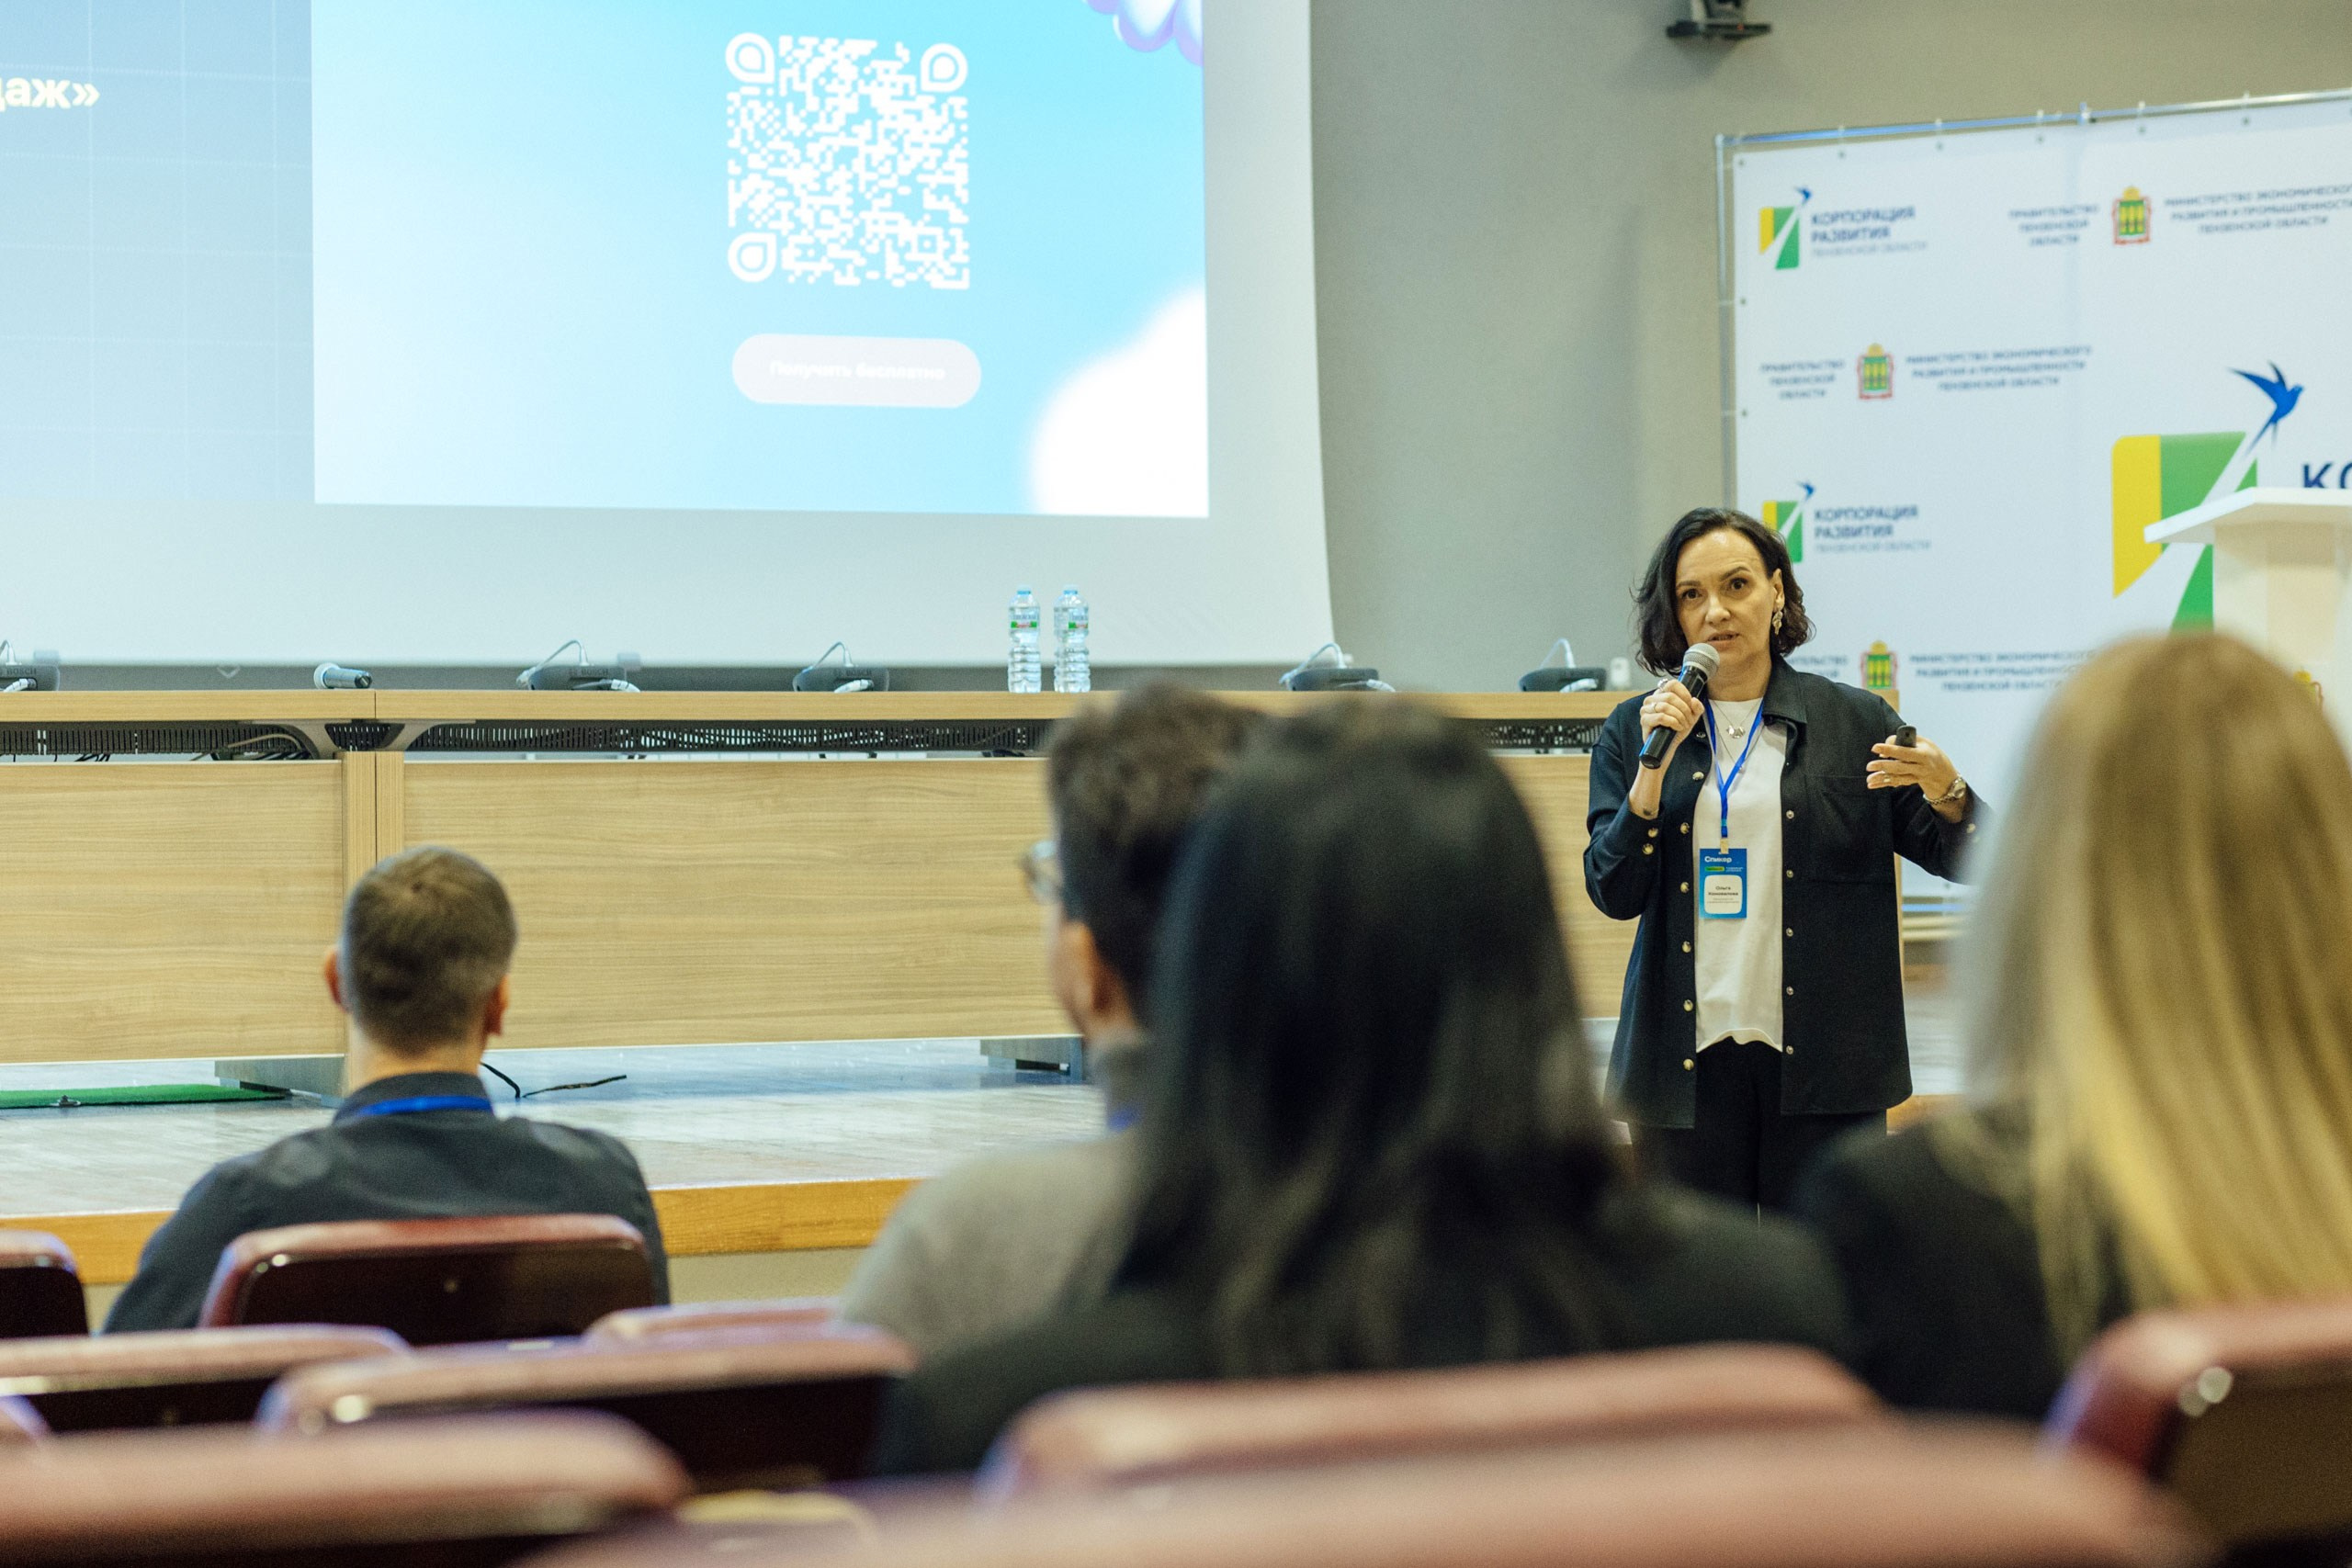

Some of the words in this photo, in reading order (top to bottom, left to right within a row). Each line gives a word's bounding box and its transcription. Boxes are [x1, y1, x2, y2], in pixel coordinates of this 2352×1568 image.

[0, 77, 100, 112] аж»
[2164, 191, 2251, 207] МИНИСТЕРСТВО
[1811, 205, 1916, 224] КОРПОРАЦИЯ
[2009, 204, 2099, 218] ПРАВИТЕЛЬСТВО
[2171, 207, 2227, 220] РАЗВИТИЯ
[2199, 219, 2271, 233] ПЕНЗЕНСКОЙ
[2277, 215, 2329, 227] ОБЛАСТИ
[1812, 227, 1891, 242] РАЗВИТИЯ
[2030, 234, 2080, 246] ОБЛАСТИ
[1905, 352, 1987, 364] МИНИСТЕРСТВО
[1993, 345, 2091, 359] ЭКОНОМИЧЕСКОГО
[769, 360, 852, 379] Получить
[855, 361, 946, 380] бесплатно
[1911, 367, 1965, 378] РАЗВИТИЯ
[1980, 360, 2086, 373] ПРОМЫШЛЕННОСТИ
[1938, 378, 2007, 391] ПЕНЗЕНСКОЙ
[2011, 376, 2060, 387] ОБЛАСТИ
[1814, 504, 1918, 521] КОРПОРАЦИЯ
[1814, 525, 1894, 539] РАЗВИТИЯ
[1909, 653, 1992, 662] МИНИСТЕРСТВО
[1916, 667, 1969, 677] РАЗВИТИЯ
[1984, 664, 2085, 676] ПРОМЫШЛЕННО
[1941, 681, 2010, 692] ПЕНЗЕНСКОЙ
